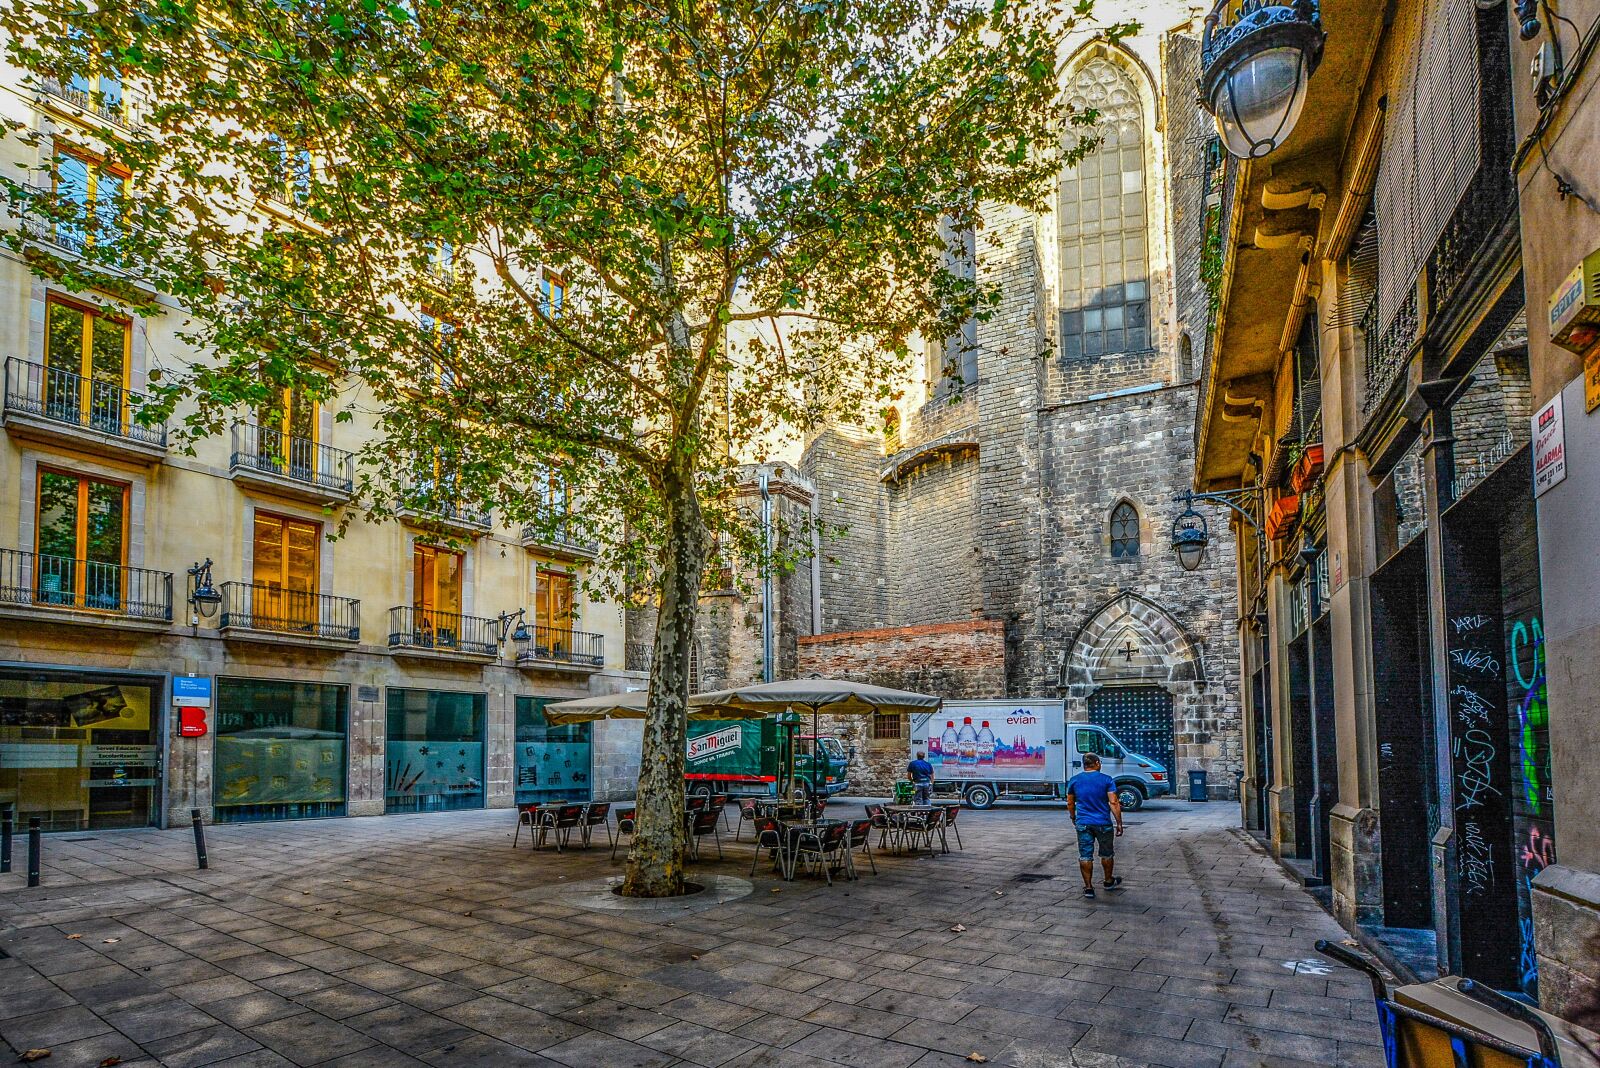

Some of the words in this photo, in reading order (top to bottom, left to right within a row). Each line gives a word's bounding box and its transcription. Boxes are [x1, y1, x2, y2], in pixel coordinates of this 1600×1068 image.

[1553, 281, 1580, 321] SPITZ
[1536, 442, 1563, 473] ALARMA
[1006, 715, 1036, 725] evian
[706, 731, 738, 749] Miguel
